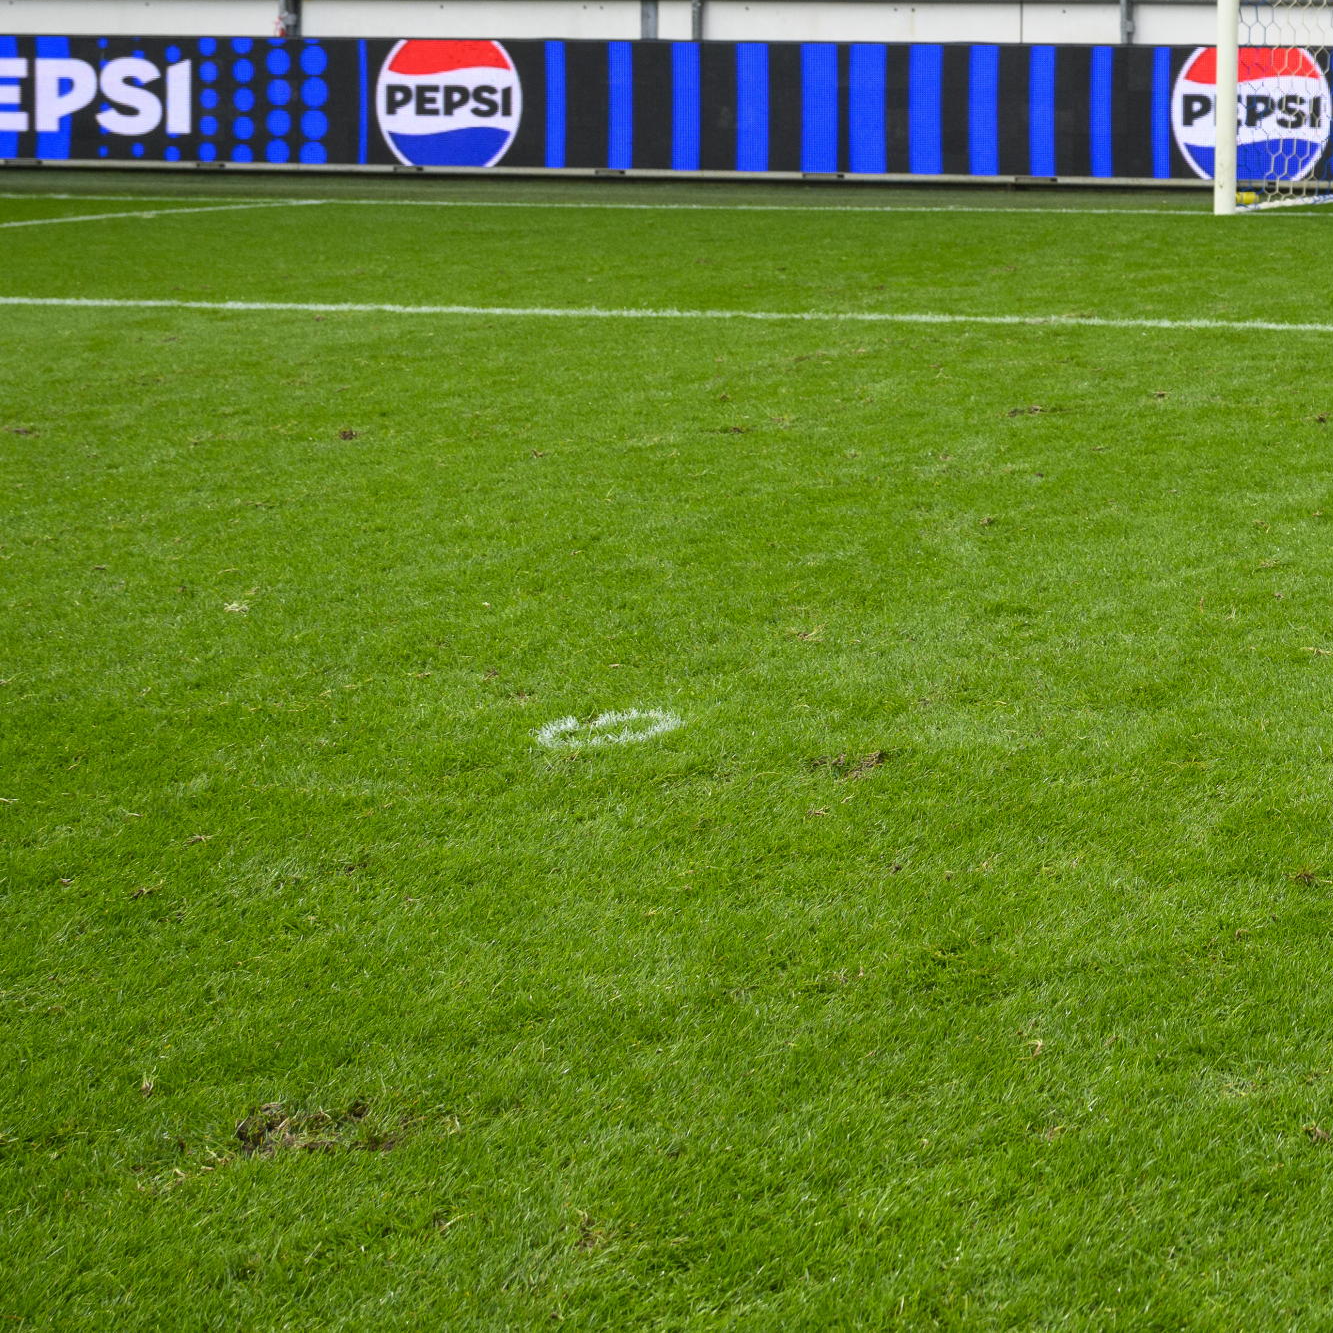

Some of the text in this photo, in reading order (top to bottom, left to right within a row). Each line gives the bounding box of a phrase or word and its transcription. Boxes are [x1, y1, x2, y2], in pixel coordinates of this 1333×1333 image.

[0, 57, 192, 136] EPSI
[386, 84, 512, 117] PEPSI
[1182, 94, 1322, 129] PPSI
